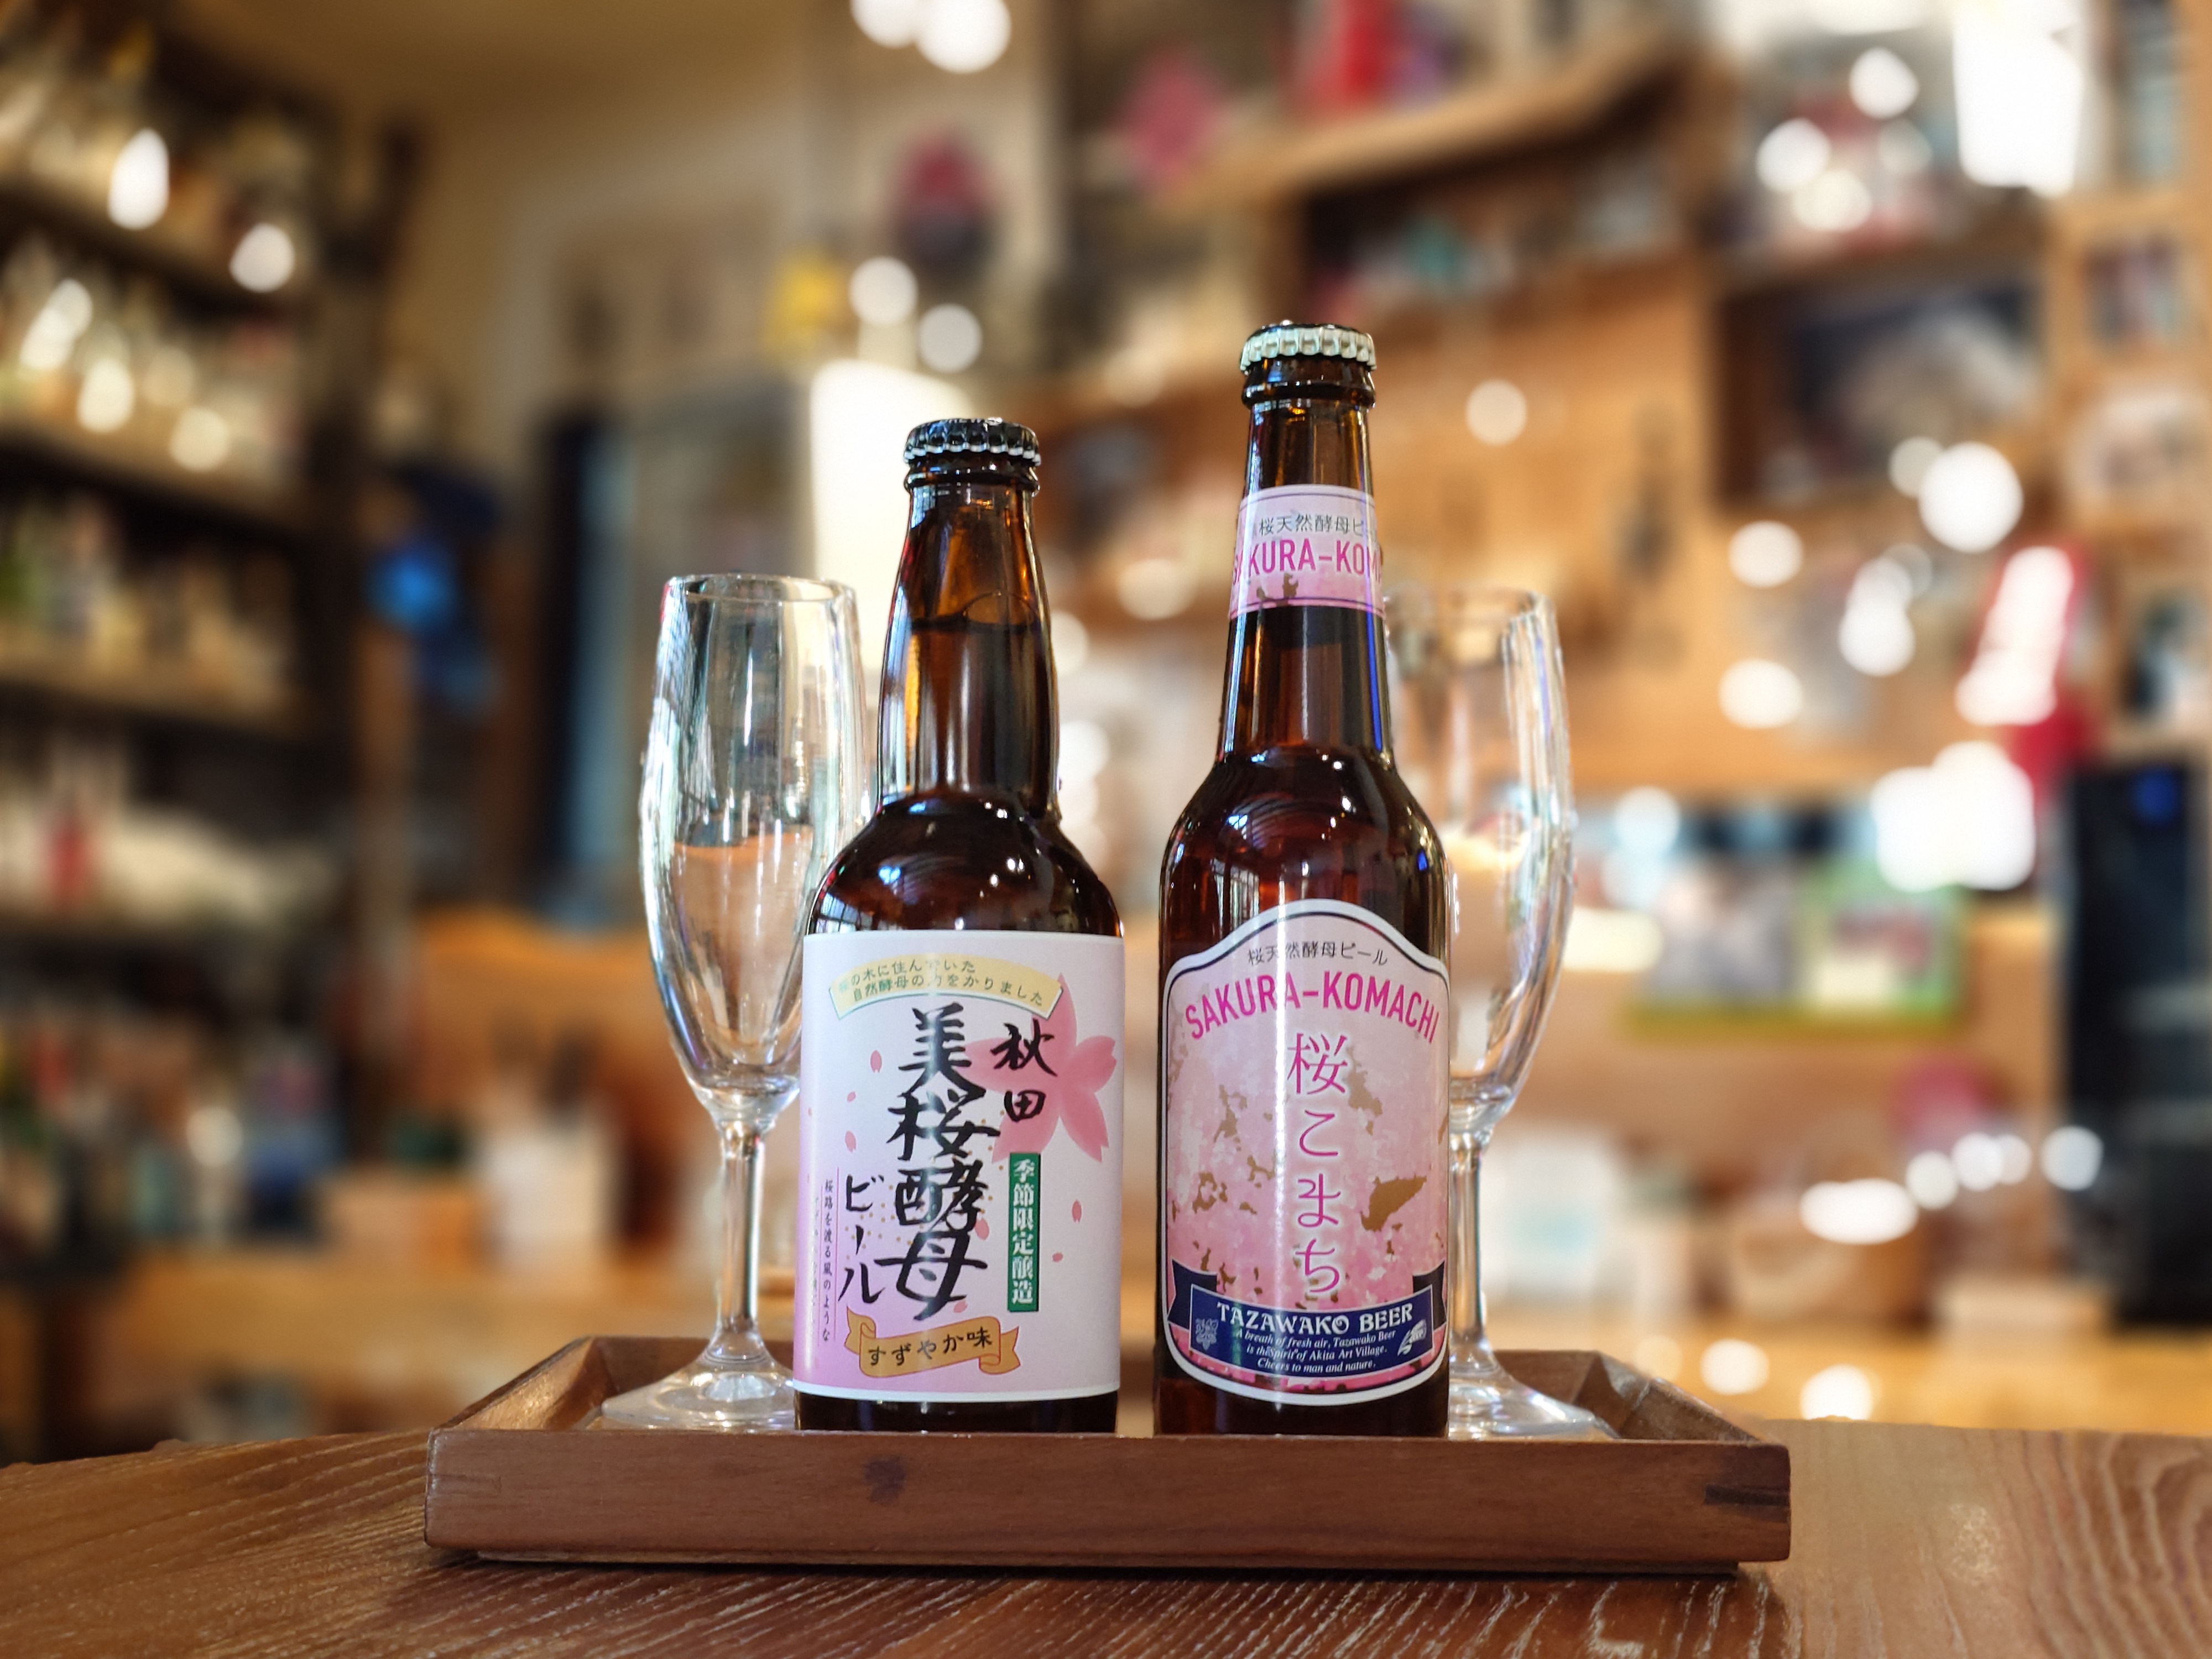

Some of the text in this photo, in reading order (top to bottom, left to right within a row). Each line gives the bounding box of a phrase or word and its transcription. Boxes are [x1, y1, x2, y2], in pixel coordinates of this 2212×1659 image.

[1186, 970, 1439, 1043] SAKURA-KOMACHI
[991, 1018, 1058, 1123] 秋田
[1287, 1032, 1348, 1293] 桜こまち
[838, 1173, 885, 1304] ビール
[1011, 1158, 1036, 1305] 季節限定醸造
[868, 1325, 993, 1367] すずやか味
[1217, 1301, 1413, 1335] TAZAWAKO BEER
[1244, 1329, 1273, 1344] breath
[1286, 1337, 1312, 1349] fresh
[1313, 1337, 1331, 1349] air,
[1333, 1333, 1376, 1348] Tazawako
[1378, 1330, 1397, 1342] Beer
[1246, 1343, 1255, 1354] is
[1296, 1350, 1308, 1363] of
[1309, 1349, 1335, 1361] Akita
[1338, 1348, 1353, 1360] Art
[1257, 1357, 1290, 1371] Cheers
[1292, 1362, 1301, 1373] to
[1303, 1364, 1323, 1373] man
[1325, 1361, 1344, 1373] and
